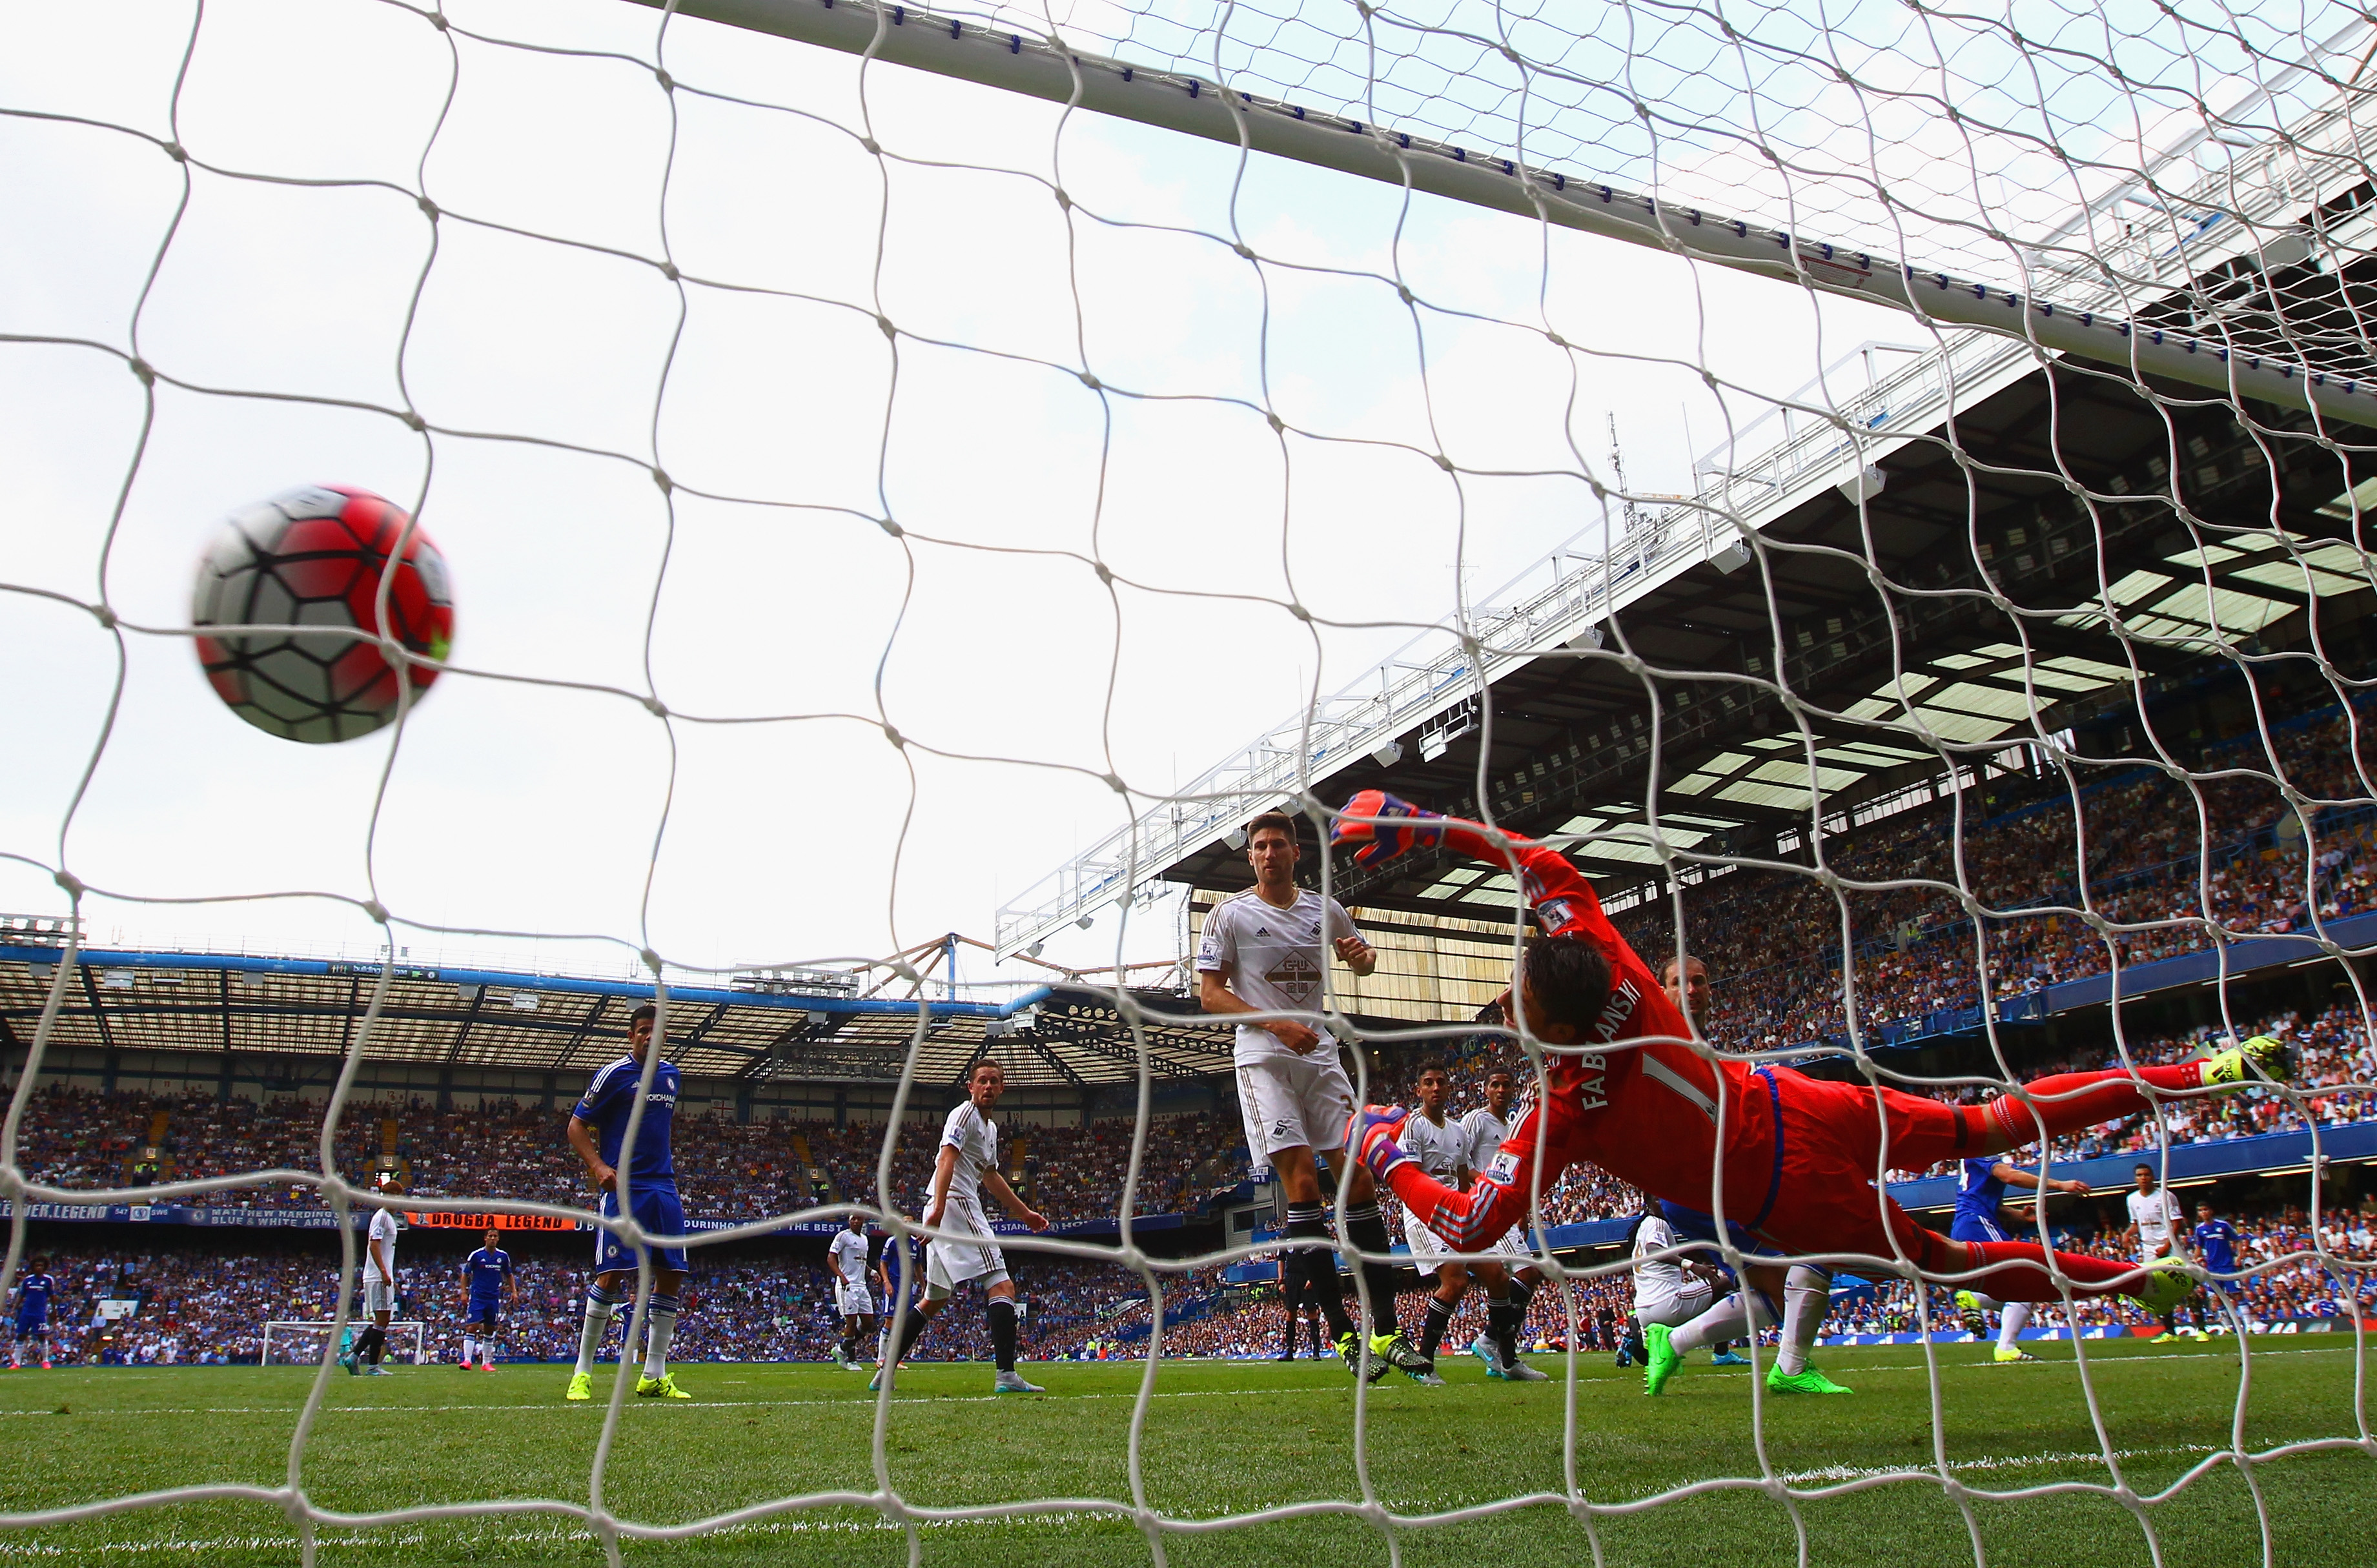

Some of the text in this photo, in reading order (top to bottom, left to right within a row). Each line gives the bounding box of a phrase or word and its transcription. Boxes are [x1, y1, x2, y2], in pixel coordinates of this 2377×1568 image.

[1581, 979, 1641, 1110] FABANSKI
[1642, 1050, 1718, 1127] 1
[212, 1209, 274, 1217] MATTHEW
[212, 1216, 243, 1225] BLUE
[258, 1217, 298, 1227] WHITE
[303, 1218, 340, 1227] ARMY
[432, 1214, 562, 1228] DROGBA LEGEND
[684, 1219, 735, 1230] OURINHO
[814, 1223, 843, 1232] BEST
